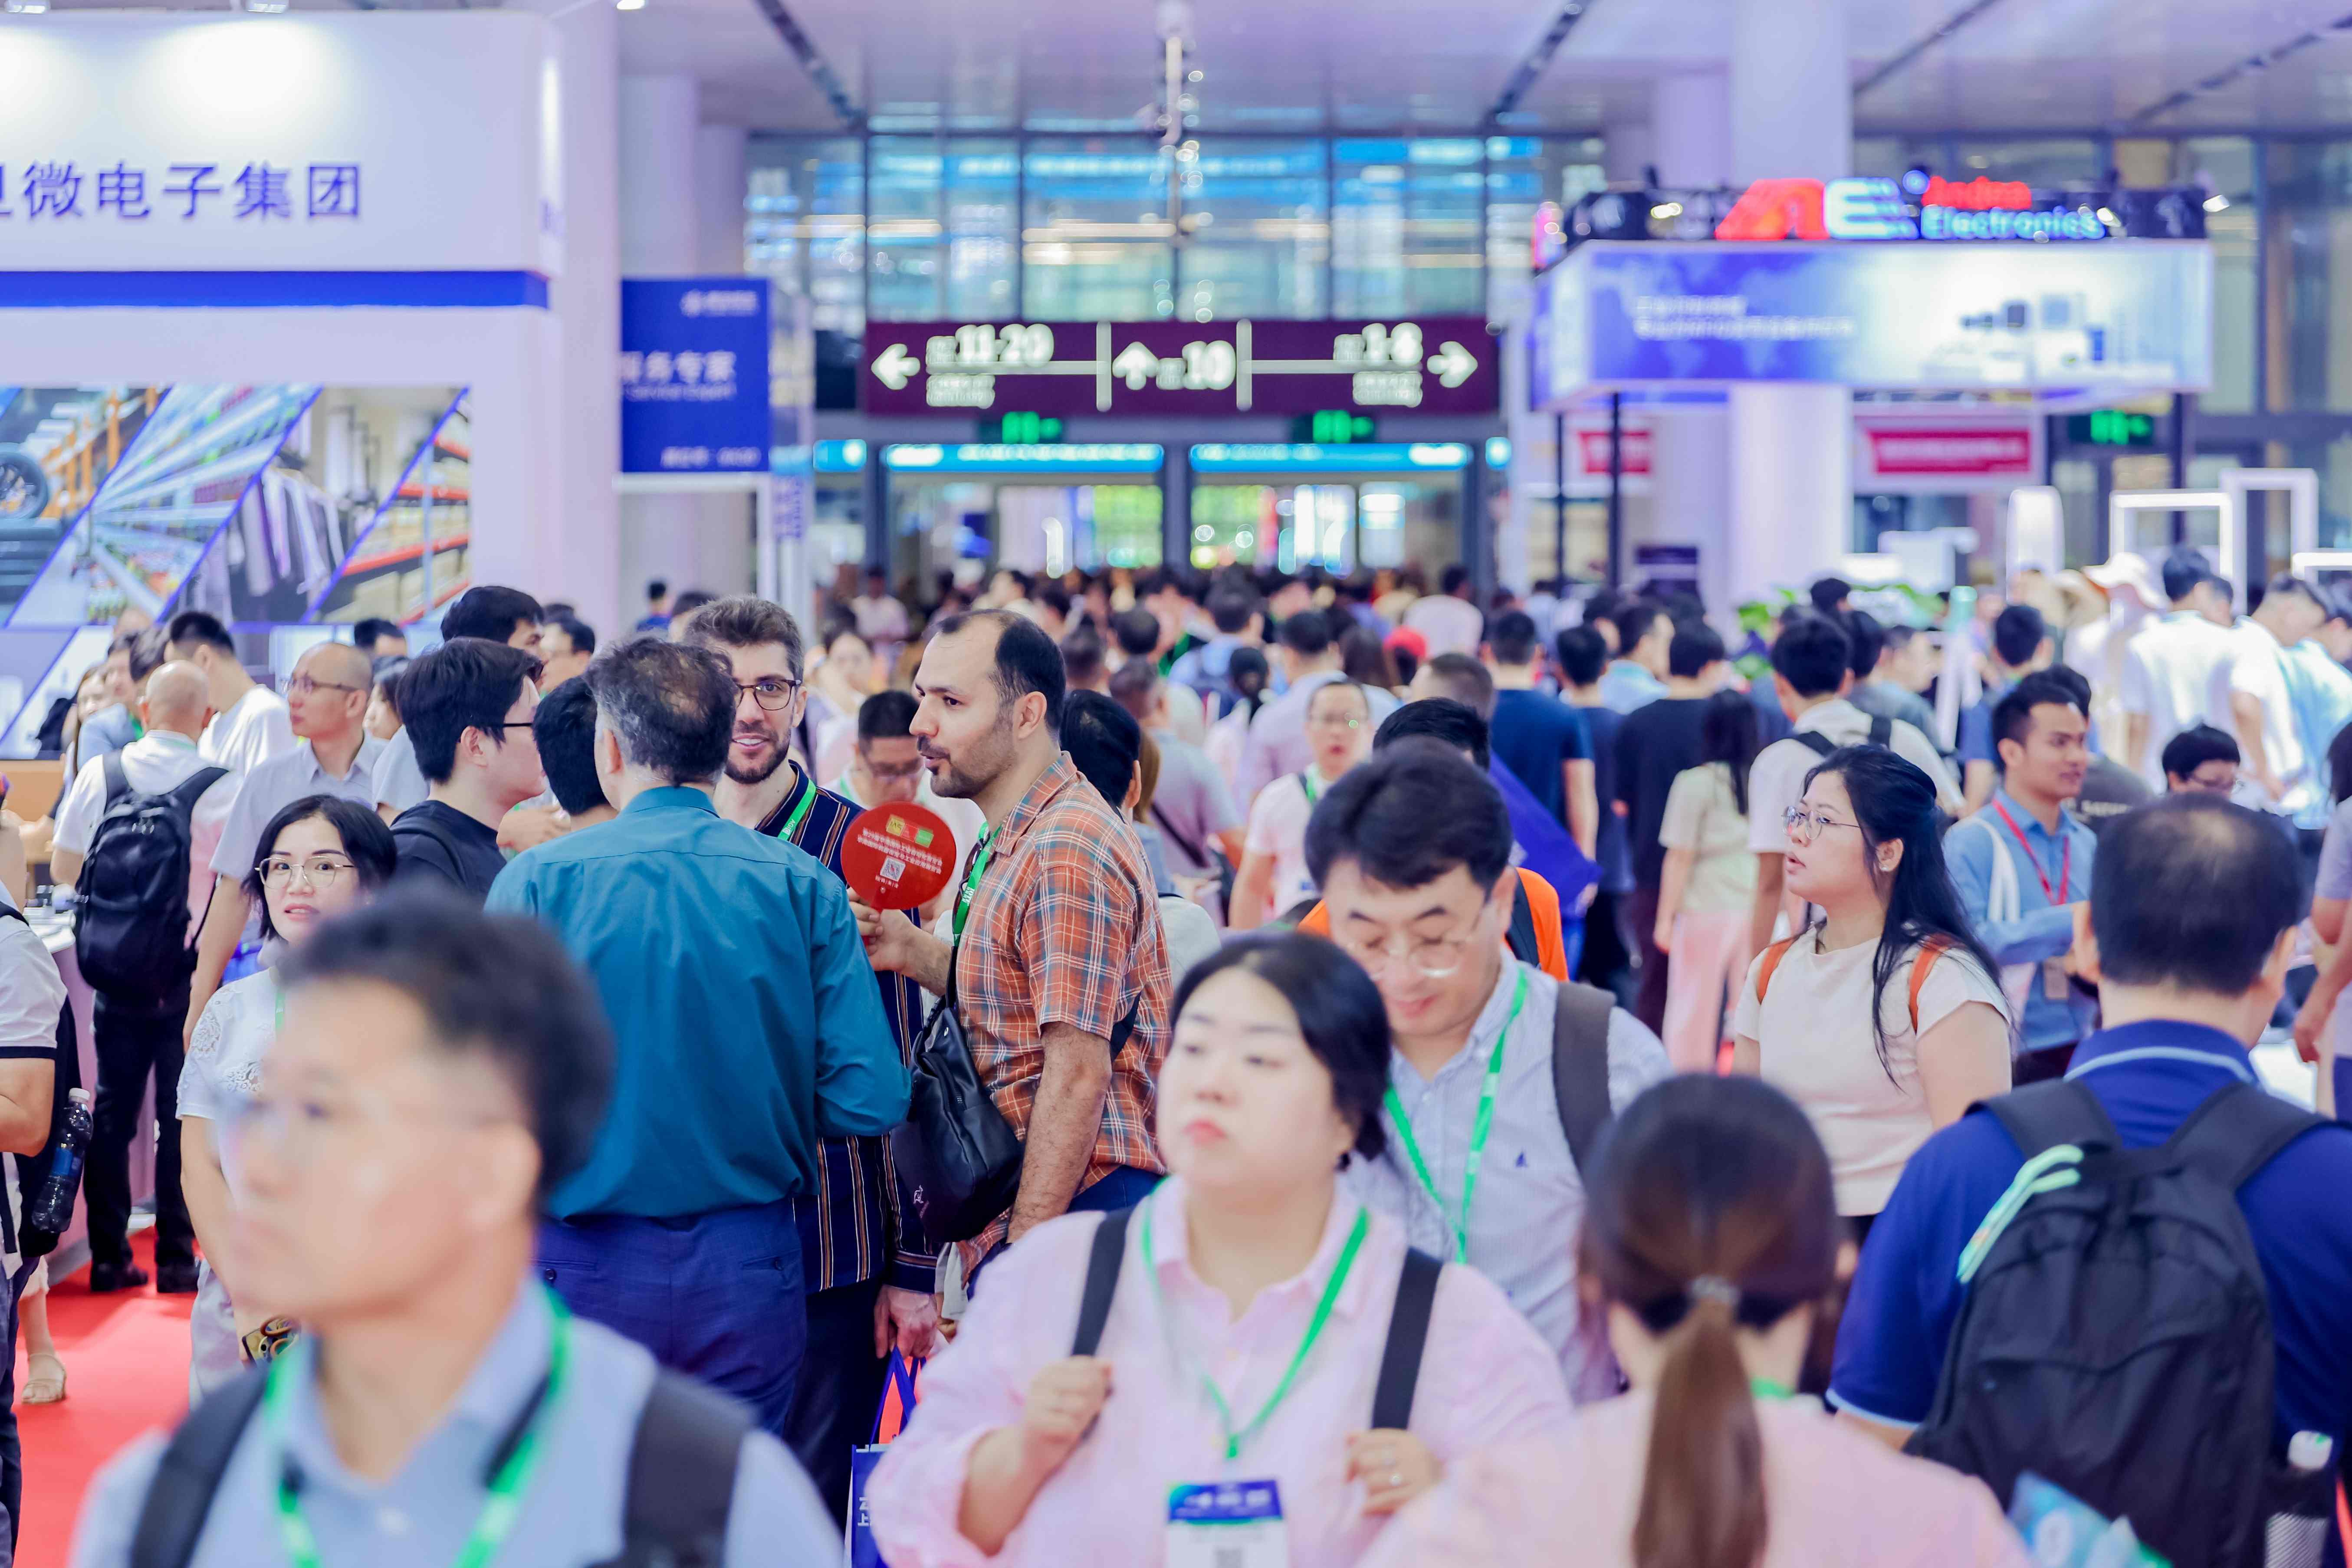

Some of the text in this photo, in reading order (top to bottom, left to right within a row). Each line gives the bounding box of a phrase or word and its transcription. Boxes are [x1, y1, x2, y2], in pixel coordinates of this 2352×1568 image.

[0, 161, 360, 219] 微电子集团
